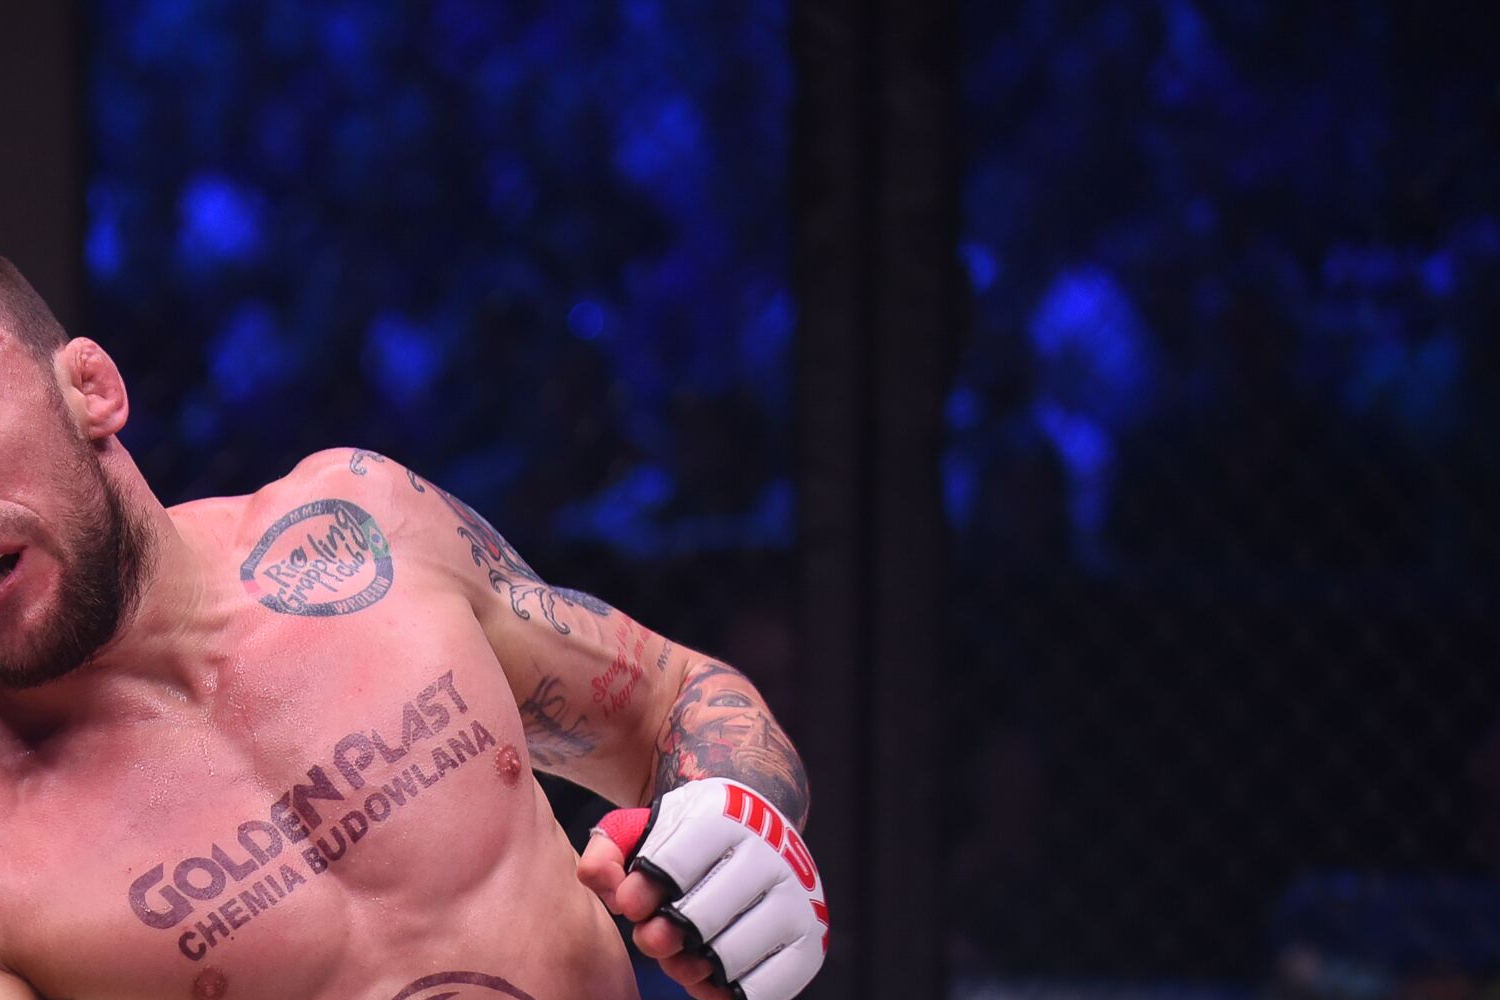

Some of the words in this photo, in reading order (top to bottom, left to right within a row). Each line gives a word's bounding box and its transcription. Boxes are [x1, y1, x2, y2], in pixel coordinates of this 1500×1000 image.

[128, 764, 345, 930] GOLDEN
[333, 669, 468, 790] PLAST
[178, 863, 307, 962] CHEMIA
[301, 719, 497, 875] BUDOWLANA
